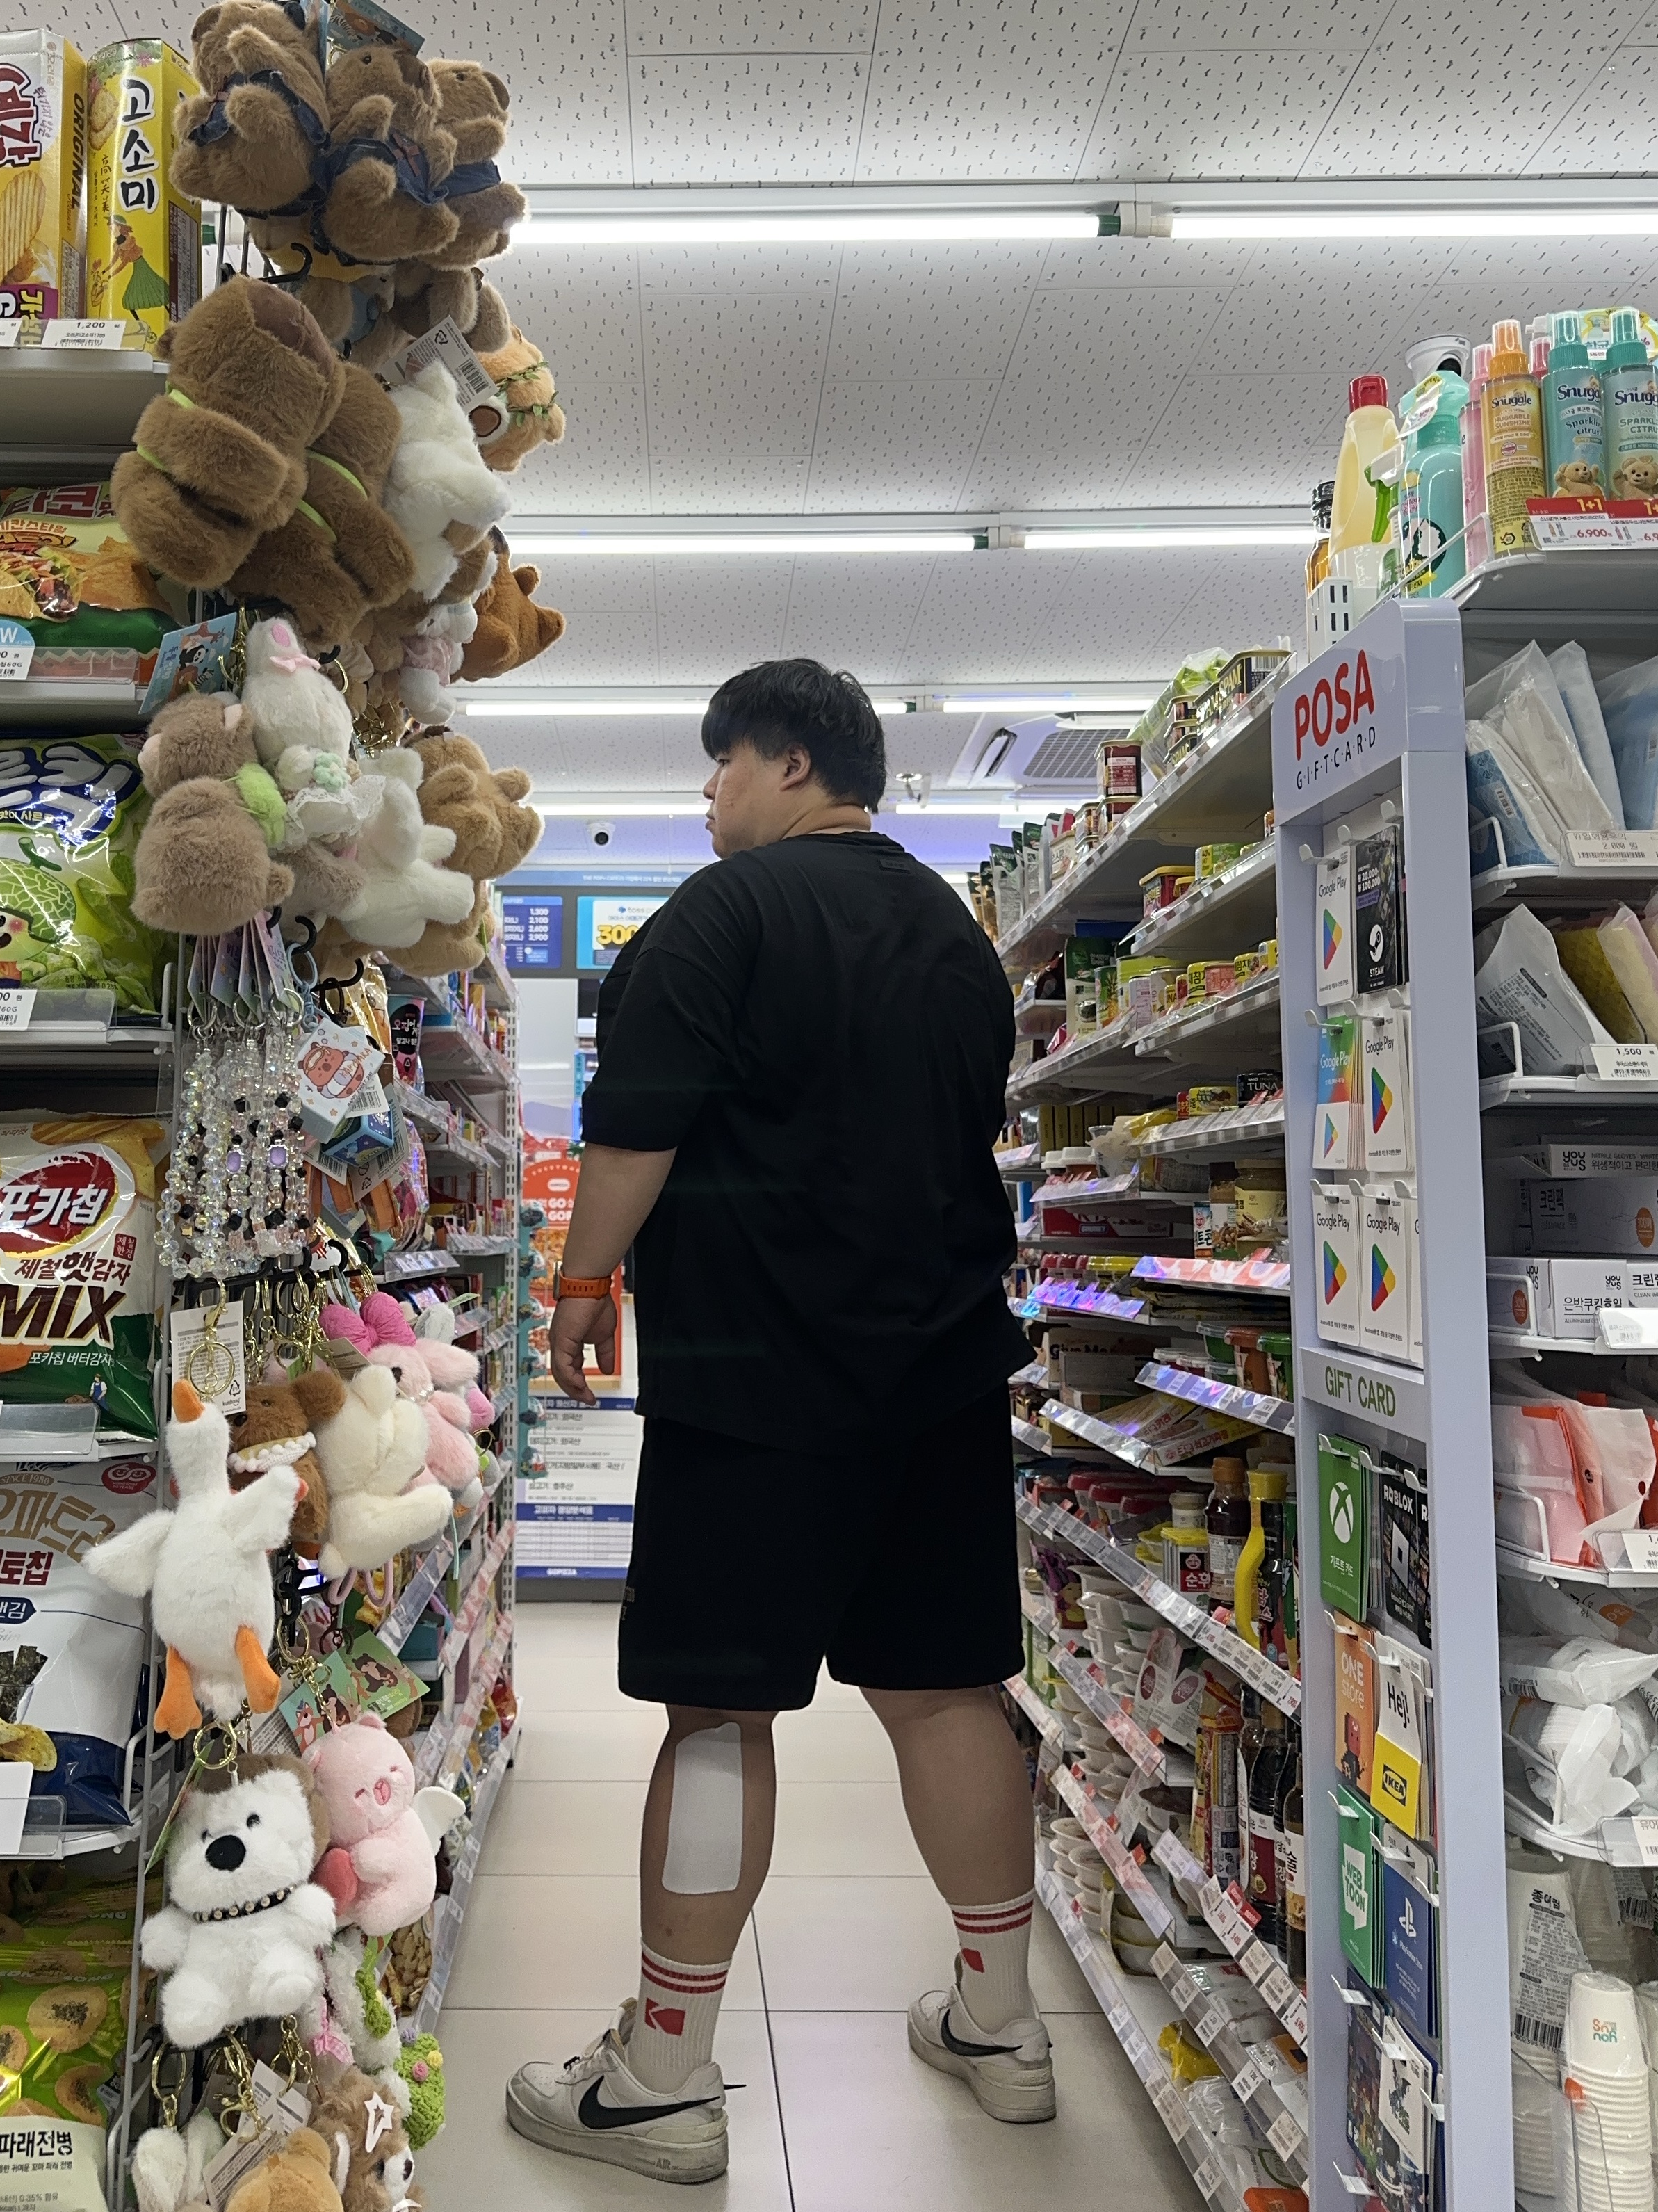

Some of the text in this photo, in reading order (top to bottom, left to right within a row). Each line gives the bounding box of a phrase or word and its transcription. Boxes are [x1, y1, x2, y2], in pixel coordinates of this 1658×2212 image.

[70, 92, 85, 211] ORIGINAL
[122, 79, 156, 209] 고소미
[1491, 393, 1532, 409] Snuggle
[1495, 414, 1530, 423] HUGGABLE
[1495, 420, 1531, 429] SUNSHINE
[1577, 498, 1604, 512] 1+1
[1577, 528, 1607, 538] 6,900
[1219, 663, 1242, 693] SPAM
[1294, 649, 1375, 761] POSA
[1318, 875, 1347, 897] Google Play
[1370, 965, 1385, 978] STEAM
[1365, 1035, 1395, 1056] Google Play
[1616, 1048, 1642, 1056] 1,500
[1321, 1050, 1351, 1071] Google Play
[1247, 1082, 1278, 1091] TUNA
[1563, 1151, 1586, 1163] you
[1570, 1159, 1586, 1171] us
[1591, 1160, 1632, 1171] 위생적이고
[0, 1184, 108, 1229] 포카칩
[1317, 1213, 1350, 1232] Google Play
[1367, 1213, 1400, 1236] Google Play
[1605, 1275, 1621, 1285] you
[1611, 1282, 1621, 1290] us
[0, 1284, 127, 1343] MIX
[28, 1351, 66, 1366] 포카칩
[1325, 1364, 1397, 1418] GIFT CARD
[1, 1472, 50, 1485] SINCE 1980
[1383, 1483, 1414, 1515] ROBLOX
[0, 1549, 54, 1586] 토칩
[1341, 1650, 1365, 1687] ONE
[1341, 1678, 1365, 1710] store
[1387, 1681, 1411, 1729] Hej!
[1384, 1773, 1406, 1798] IKEA
[1345, 1859, 1363, 1890] WEB
[1345, 1883, 1366, 1912] TOON
[0, 2130, 72, 2158] 파래전병
